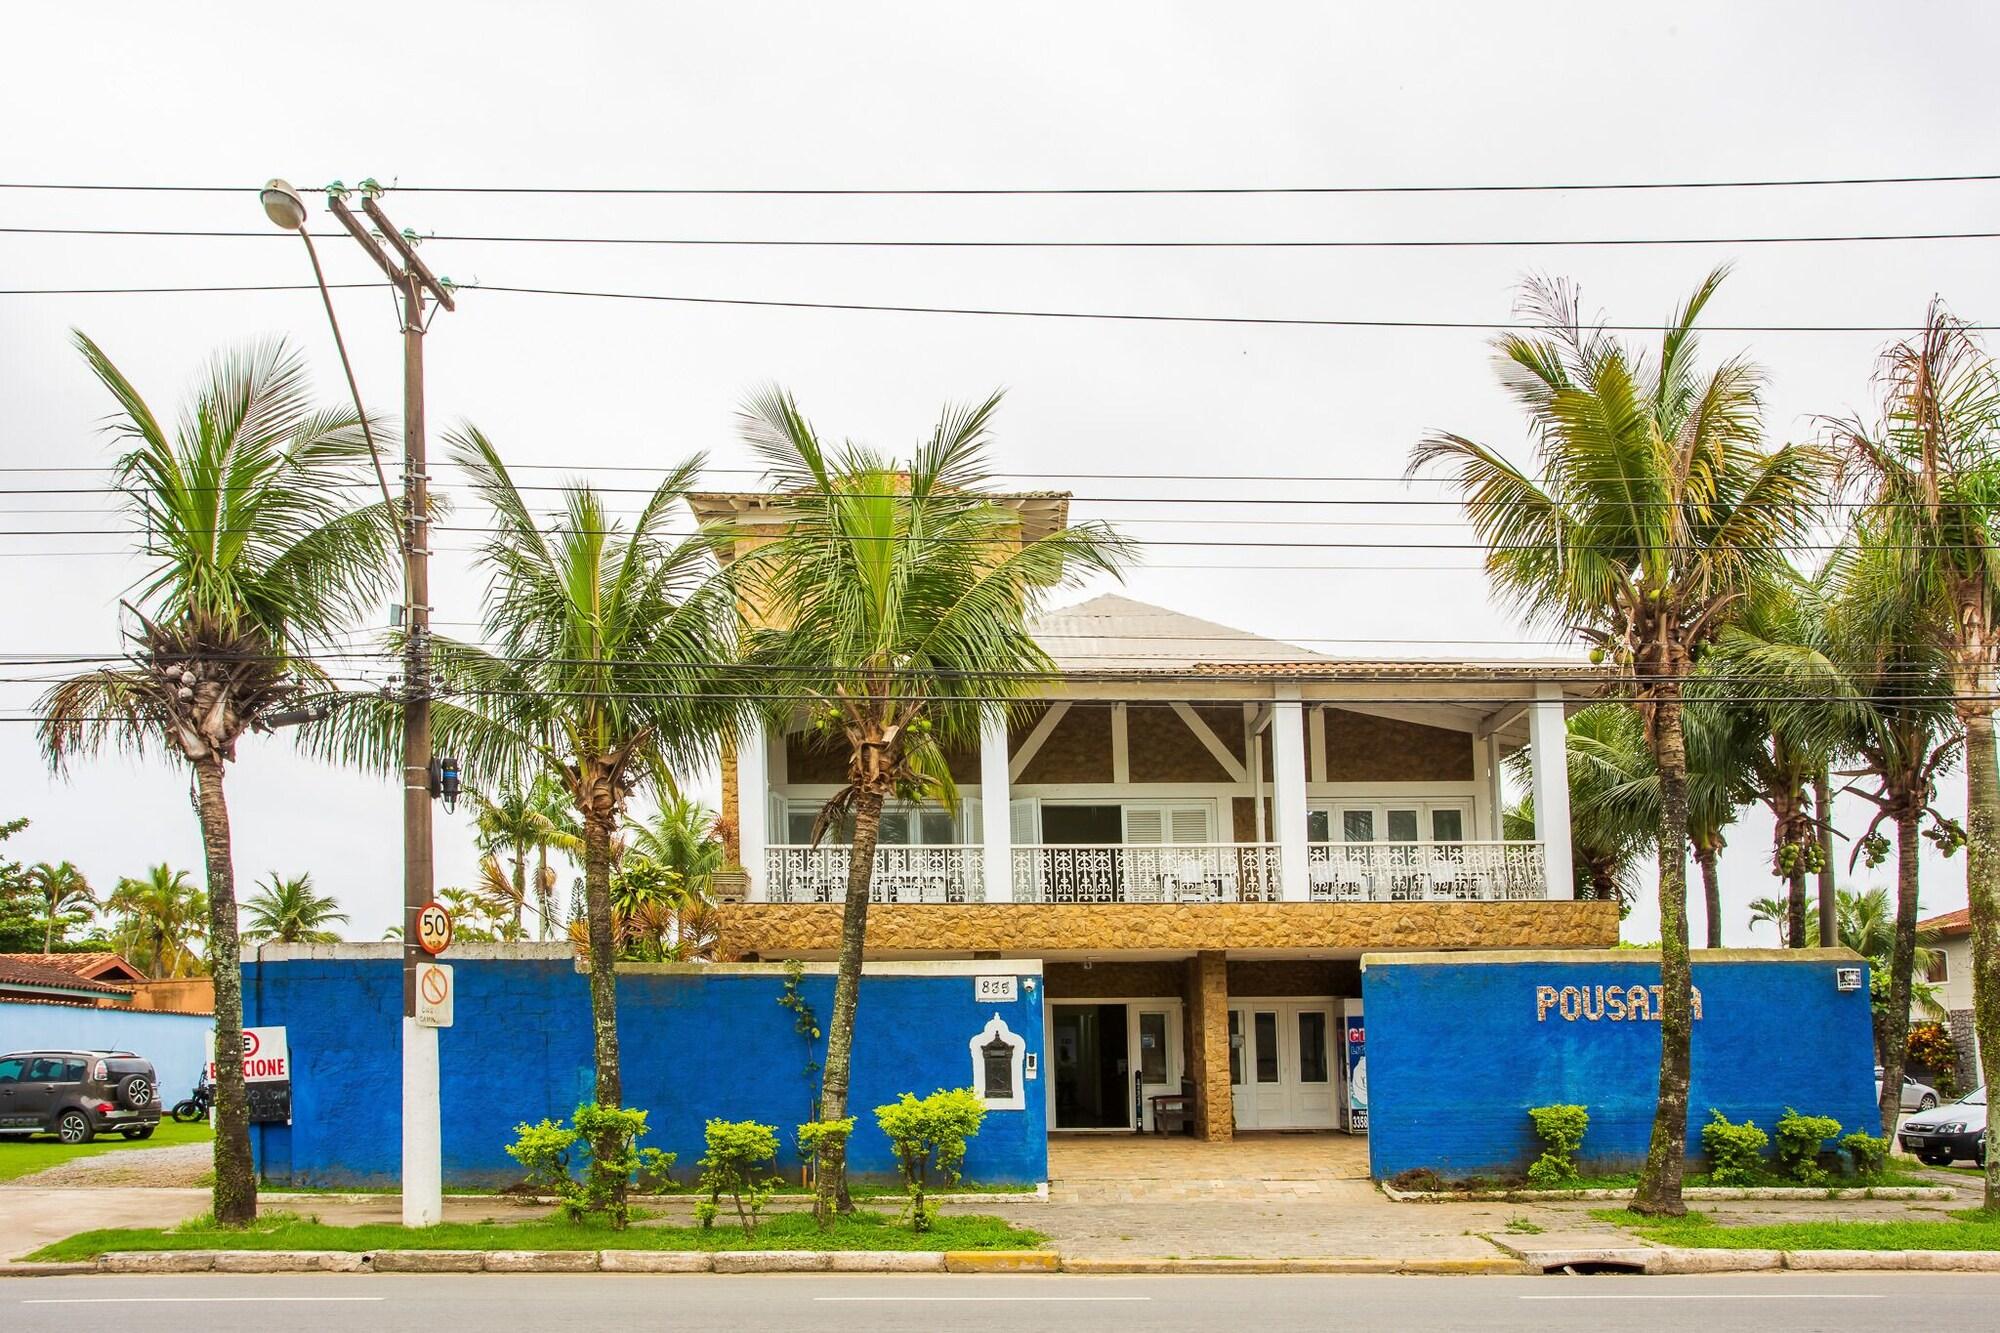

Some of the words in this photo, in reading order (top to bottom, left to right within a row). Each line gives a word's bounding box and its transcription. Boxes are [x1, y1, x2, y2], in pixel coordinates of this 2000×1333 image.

[424, 914, 446, 936] 50
[981, 980, 1010, 995] 835
[243, 1038, 251, 1052] E
[210, 1058, 285, 1080] ECIONE
